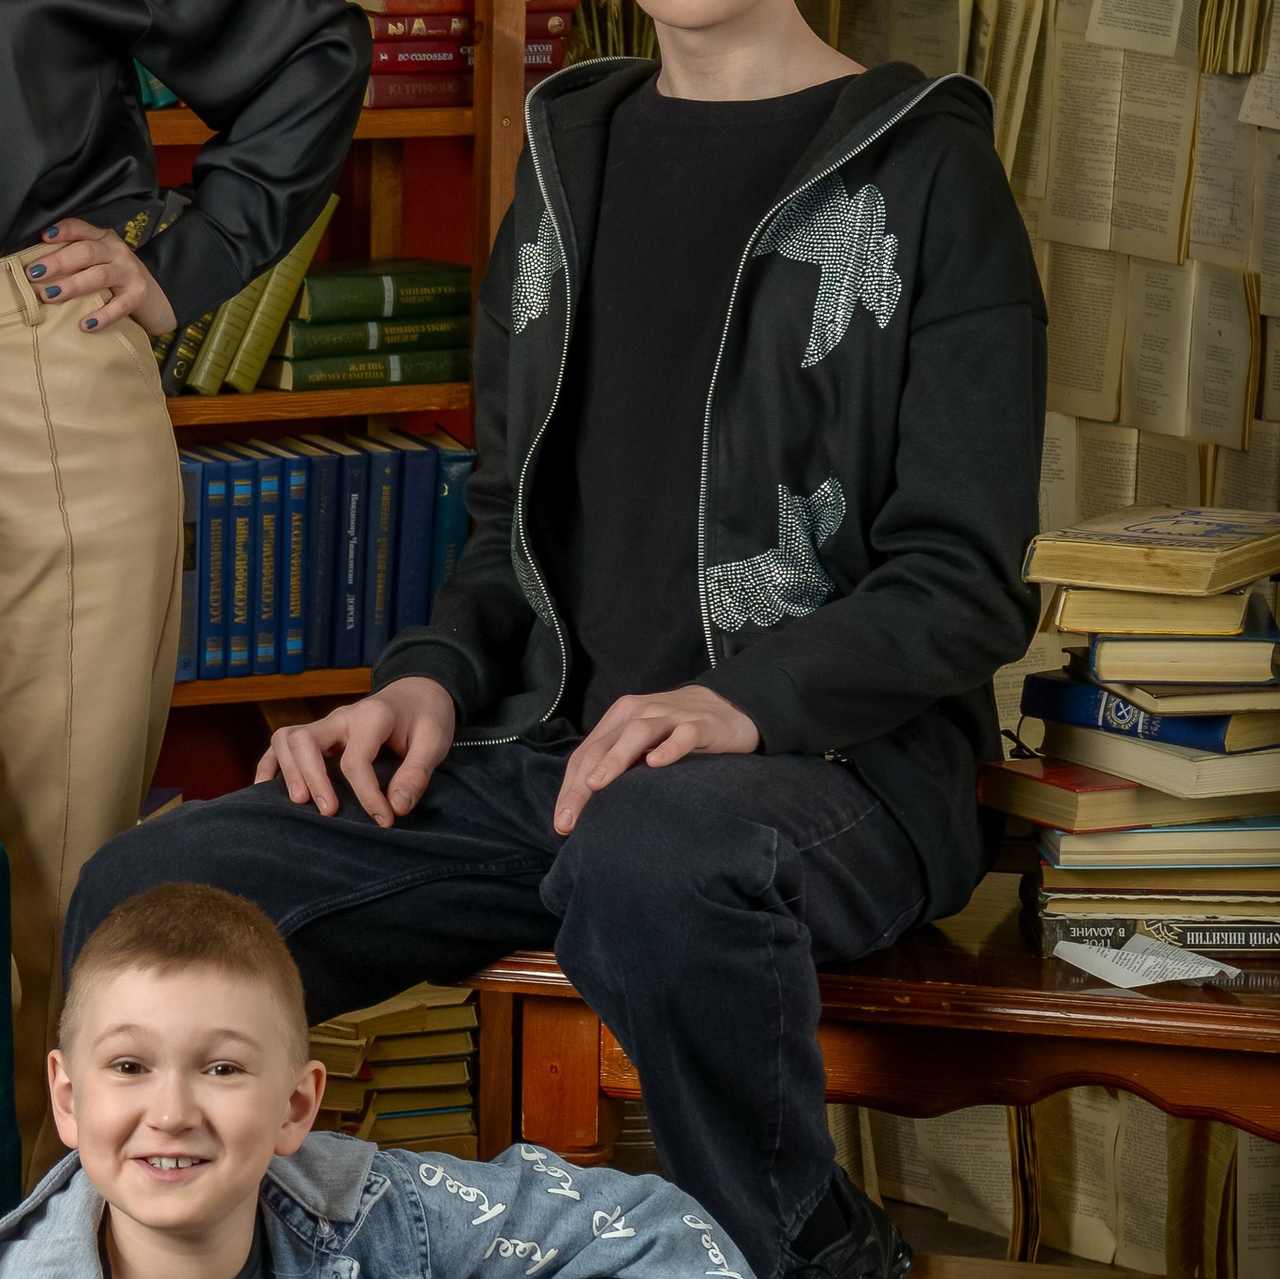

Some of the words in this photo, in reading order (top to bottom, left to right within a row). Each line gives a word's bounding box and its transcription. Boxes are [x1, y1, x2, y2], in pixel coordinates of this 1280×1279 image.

[348, 492, 359, 536] Владимир
[346, 594, 356, 630] ДОРОГА
[1070, 927, 1115, 939] ДОЛИНЕ
[1118, 927, 1126, 938] В
[1186, 931, 1247, 945] НИКИТИН
[419, 1162, 507, 1226] keep
